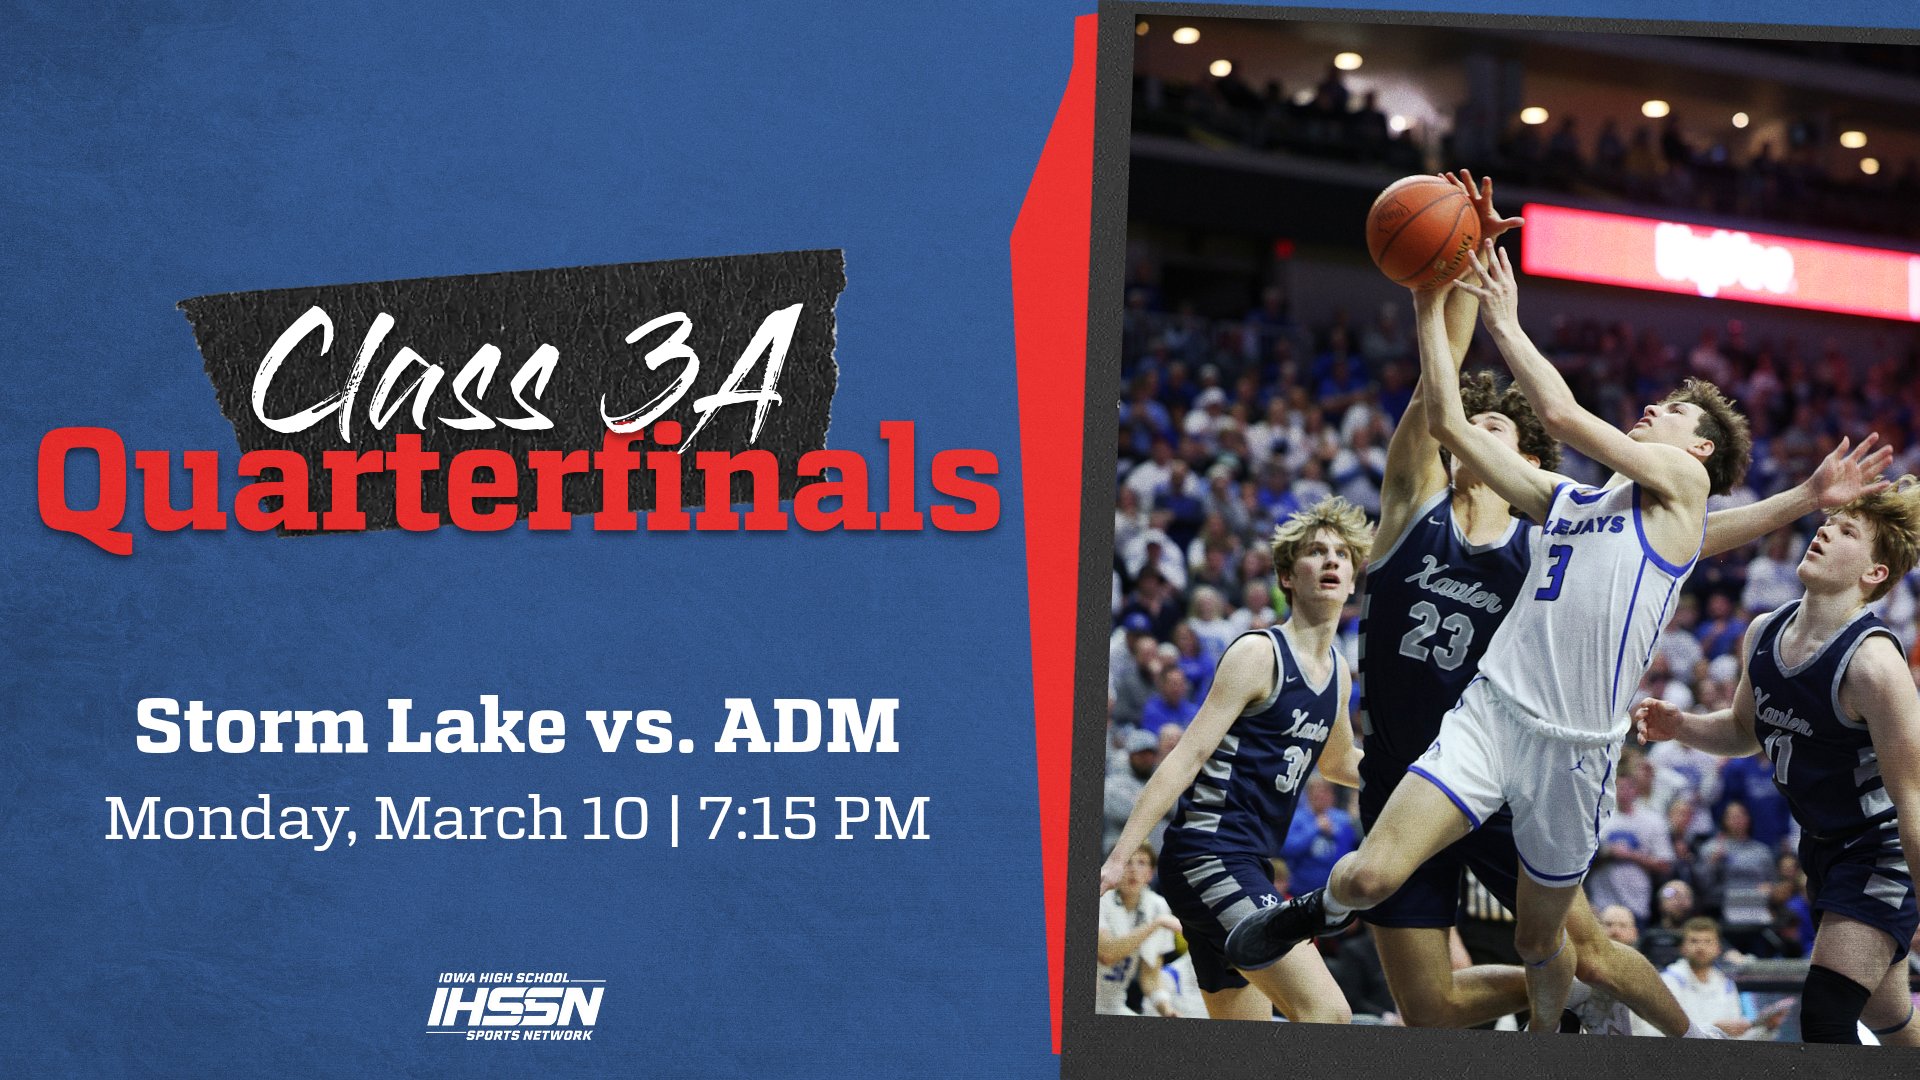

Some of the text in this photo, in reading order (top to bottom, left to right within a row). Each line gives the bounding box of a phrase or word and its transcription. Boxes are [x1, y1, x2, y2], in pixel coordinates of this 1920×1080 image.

[1404, 554, 1503, 614] Xavier
[1534, 544, 1574, 602] 3
[1399, 600, 1475, 671] 23
